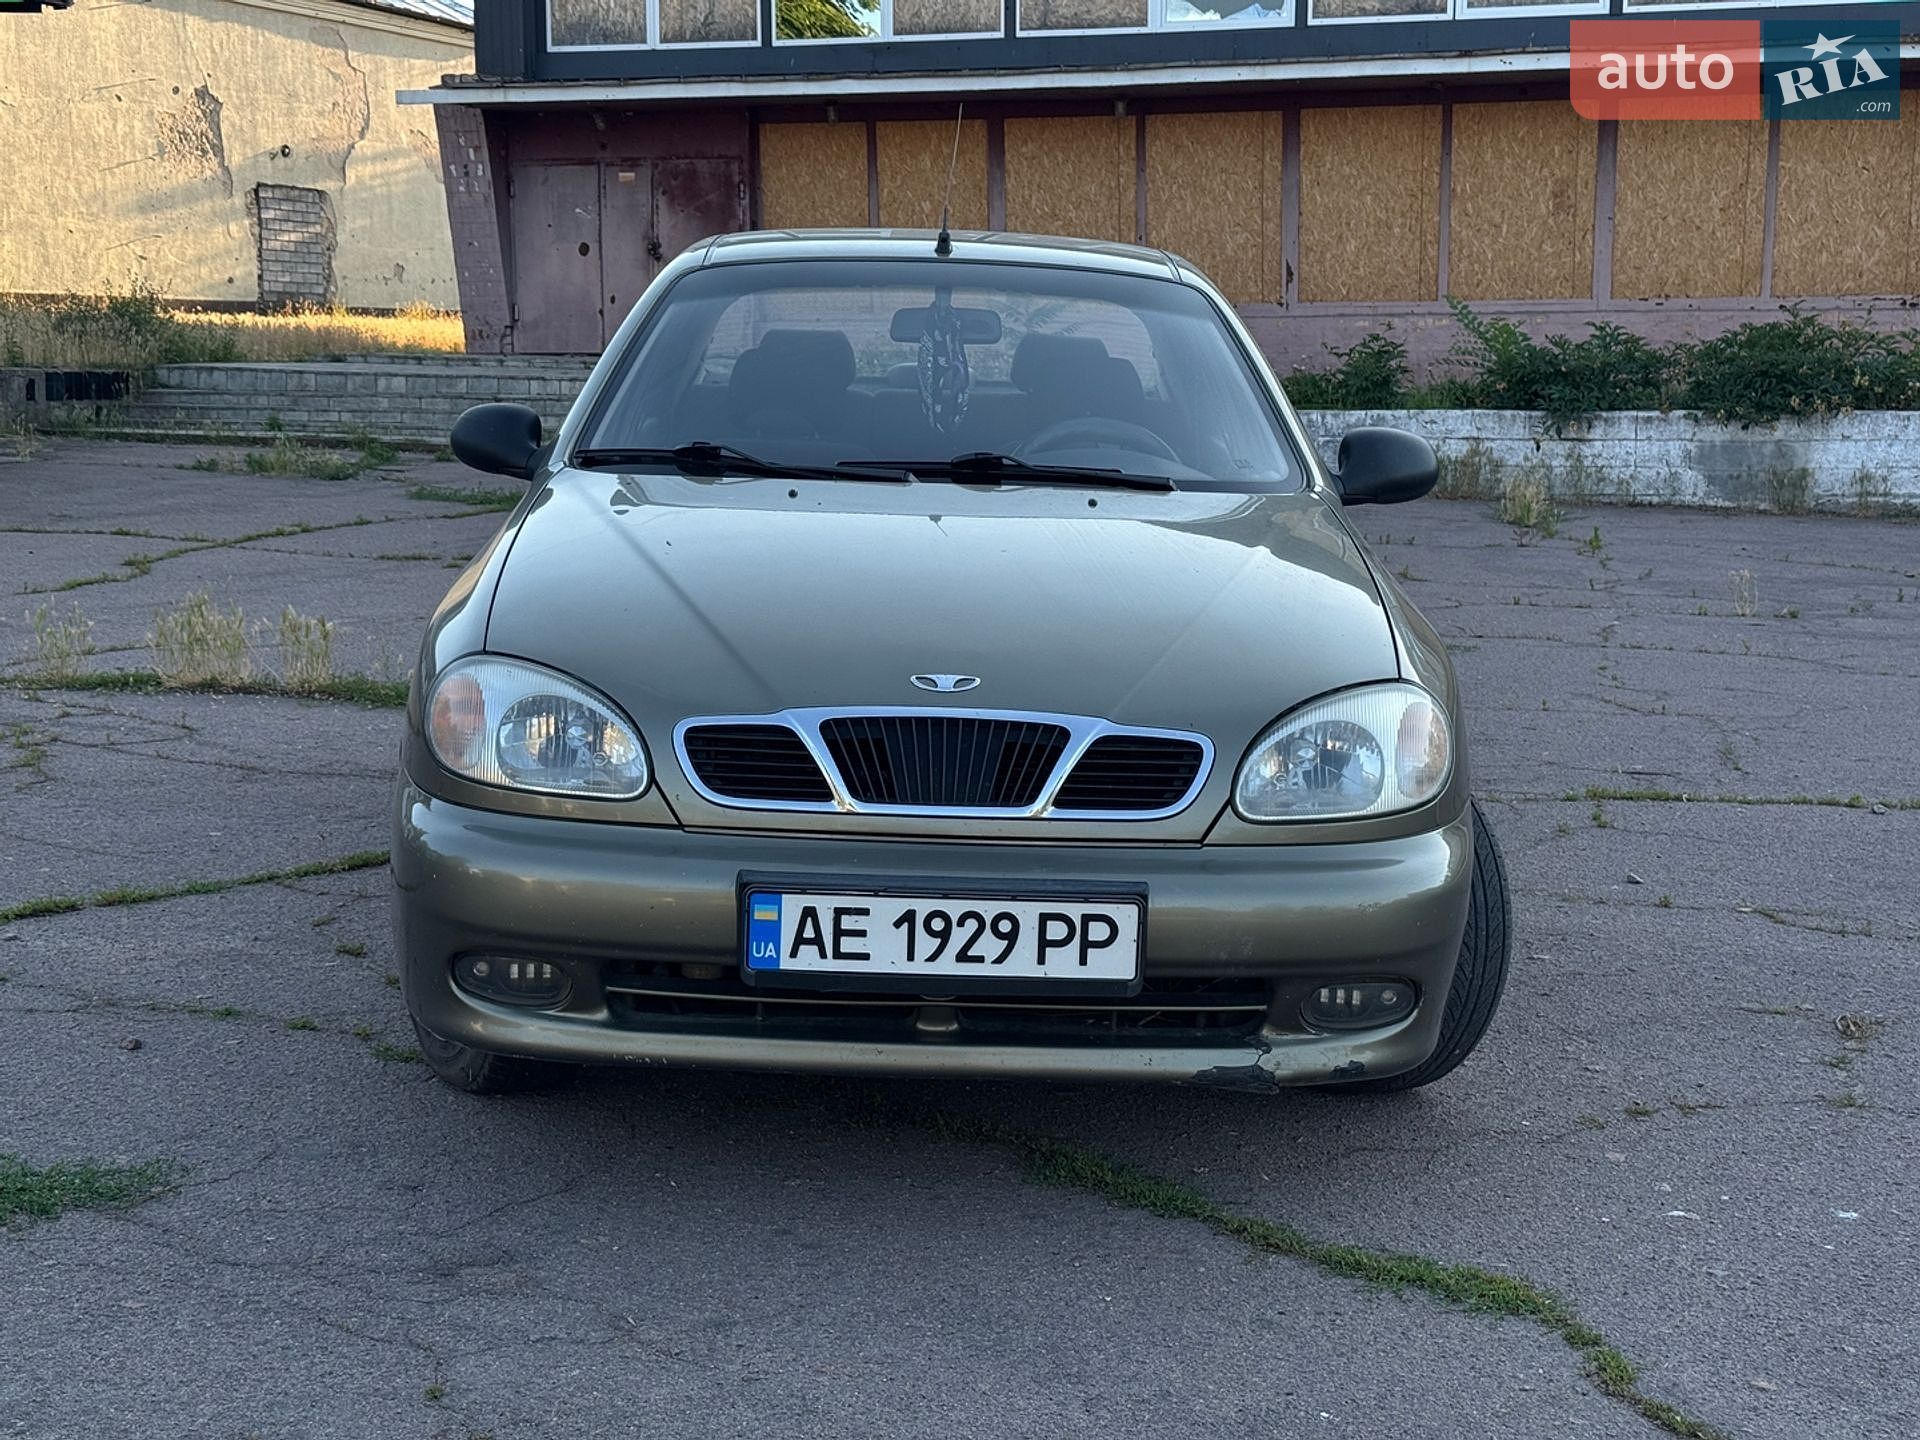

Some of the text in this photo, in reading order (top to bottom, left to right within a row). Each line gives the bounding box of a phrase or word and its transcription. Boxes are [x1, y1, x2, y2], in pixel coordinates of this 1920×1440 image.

[752, 941, 777, 958] UA
[788, 905, 1119, 967] AE 1929 PP
